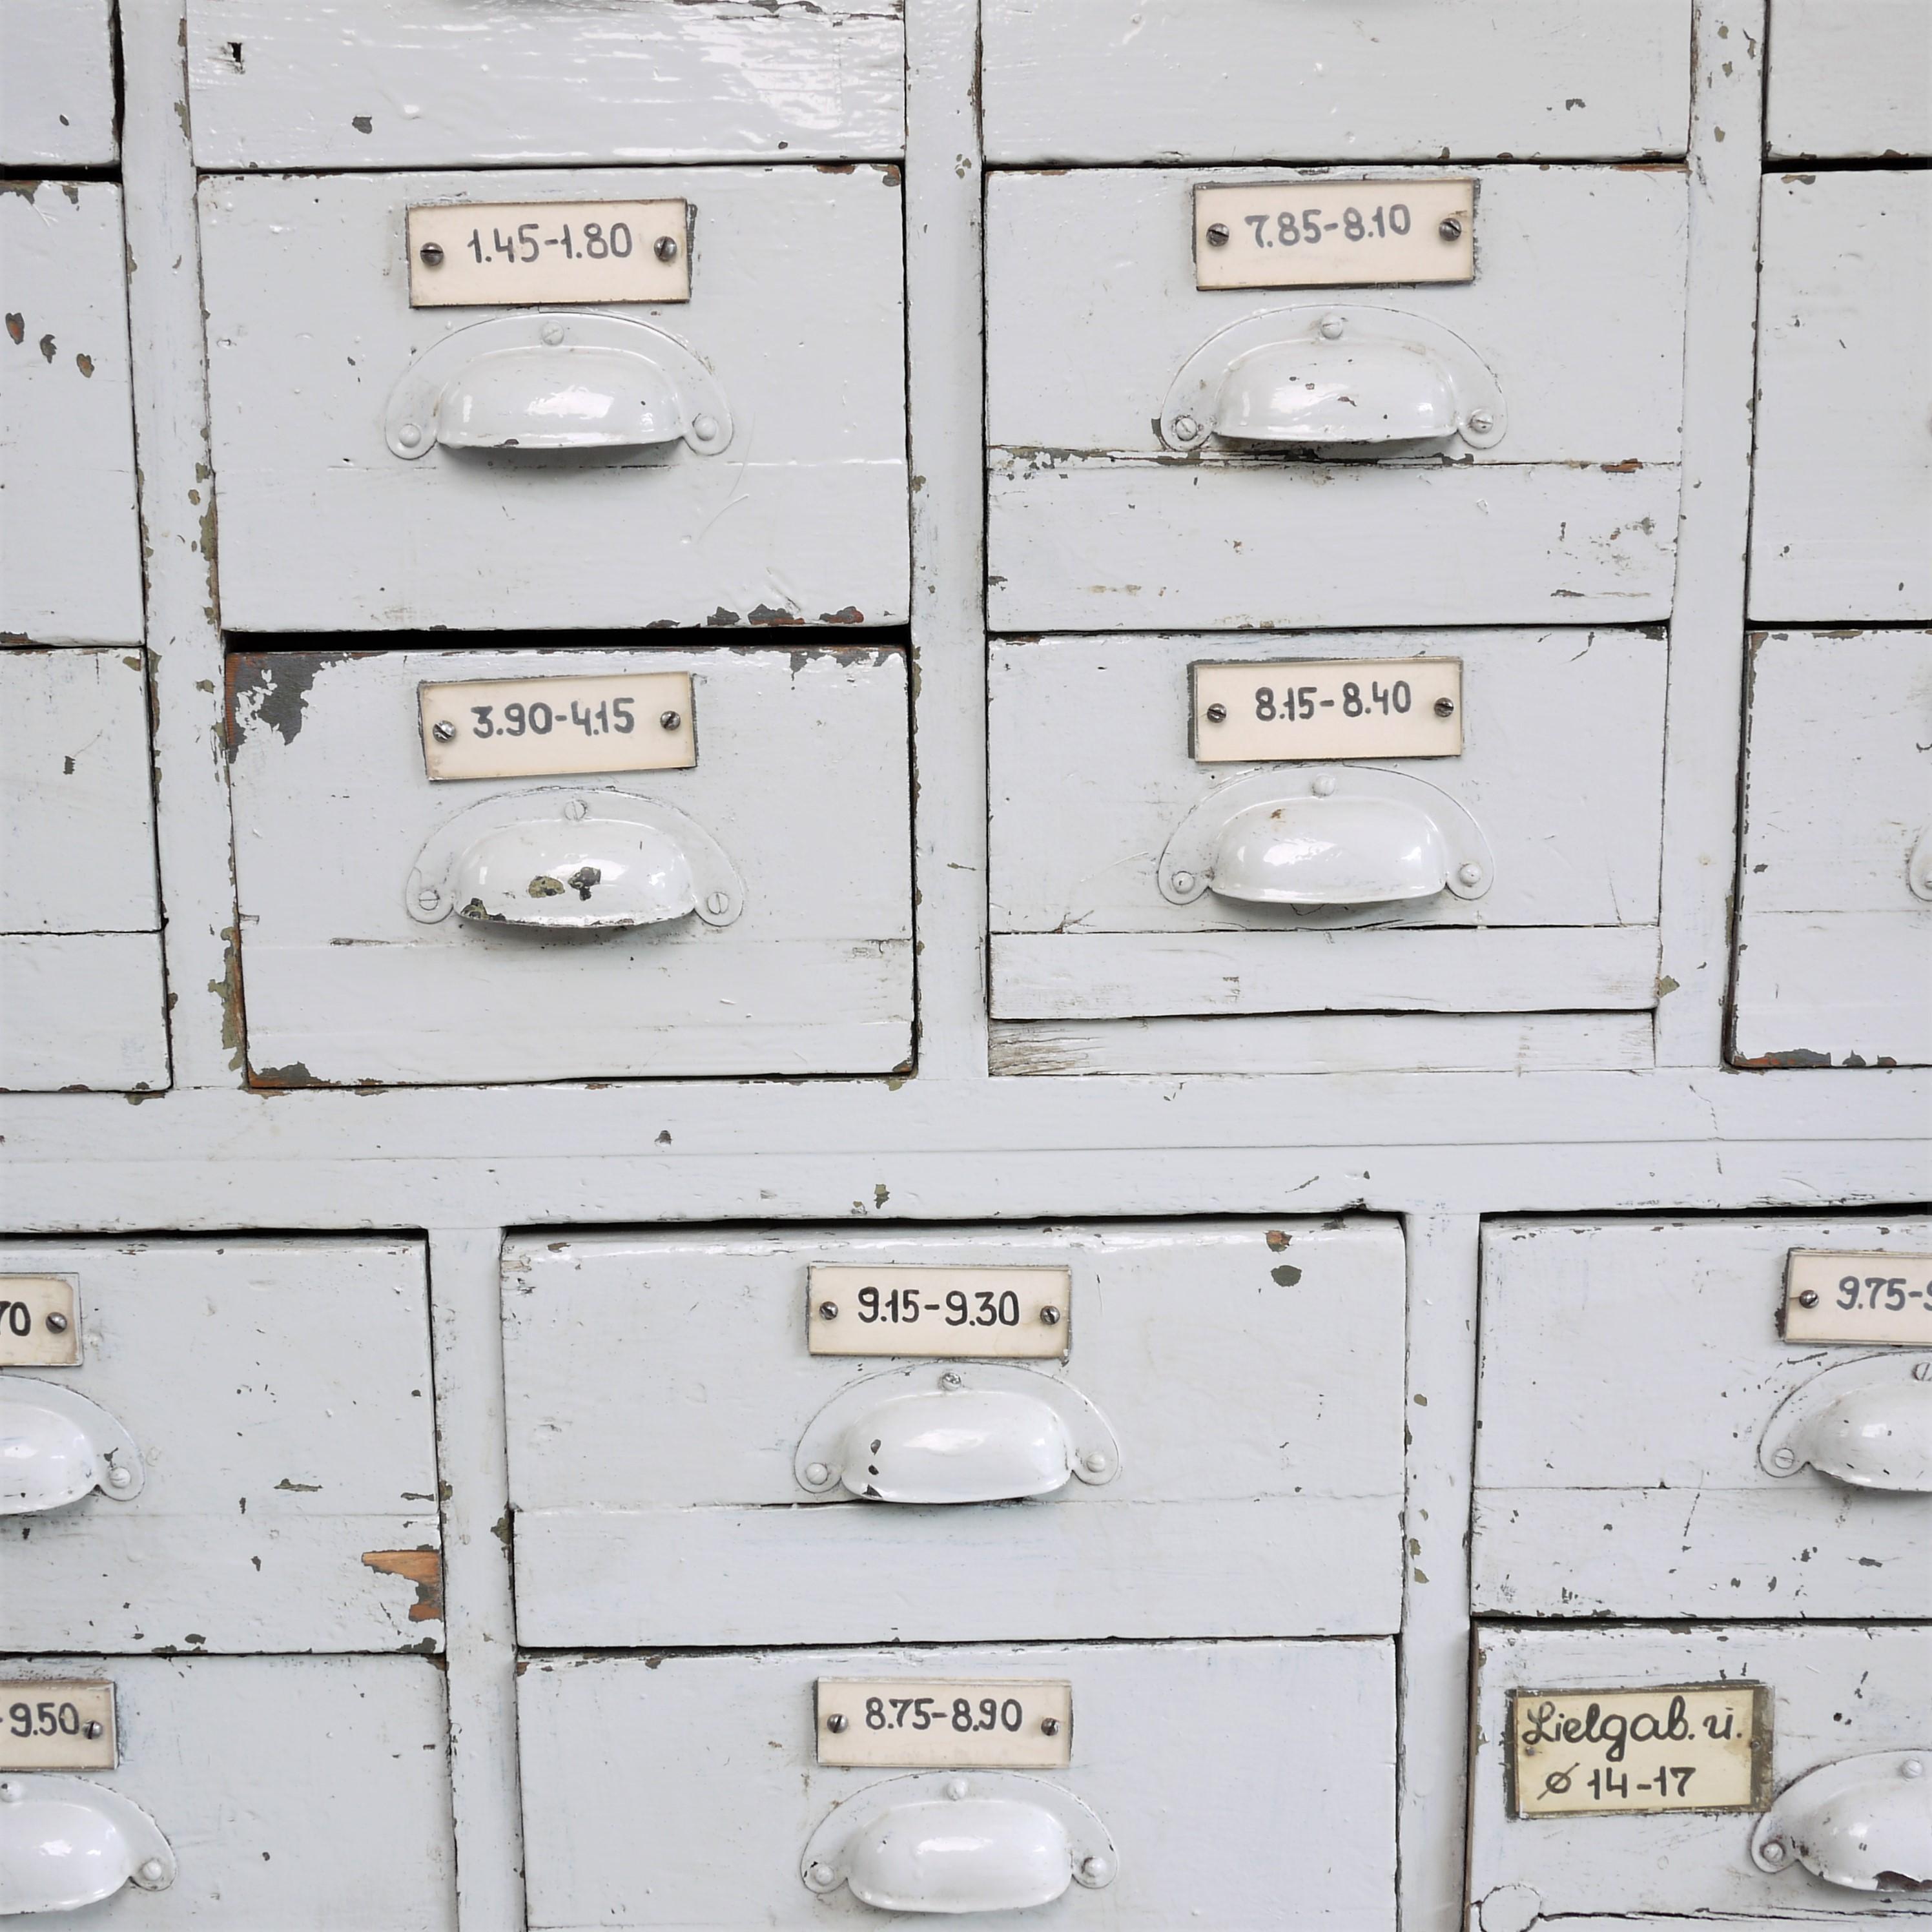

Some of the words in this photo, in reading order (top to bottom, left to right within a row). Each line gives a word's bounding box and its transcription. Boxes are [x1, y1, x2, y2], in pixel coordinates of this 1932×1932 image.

[467, 222, 632, 263] 1.45-1.80
[1244, 204, 1411, 248] 7.85-8.10
[471, 697, 635, 739] 3.90-4.15
[1255, 680, 1412, 722] 8.15-8.40
[858, 1286, 1020, 1327] 9.15-9.30
[0, 1702, 79, 1738] 9.50
[865, 1696, 1023, 1732] 8.75-8.90
[1521, 1694, 1696, 1763] Lielgab.
[1587, 1765, 1697, 1801] 14-17
